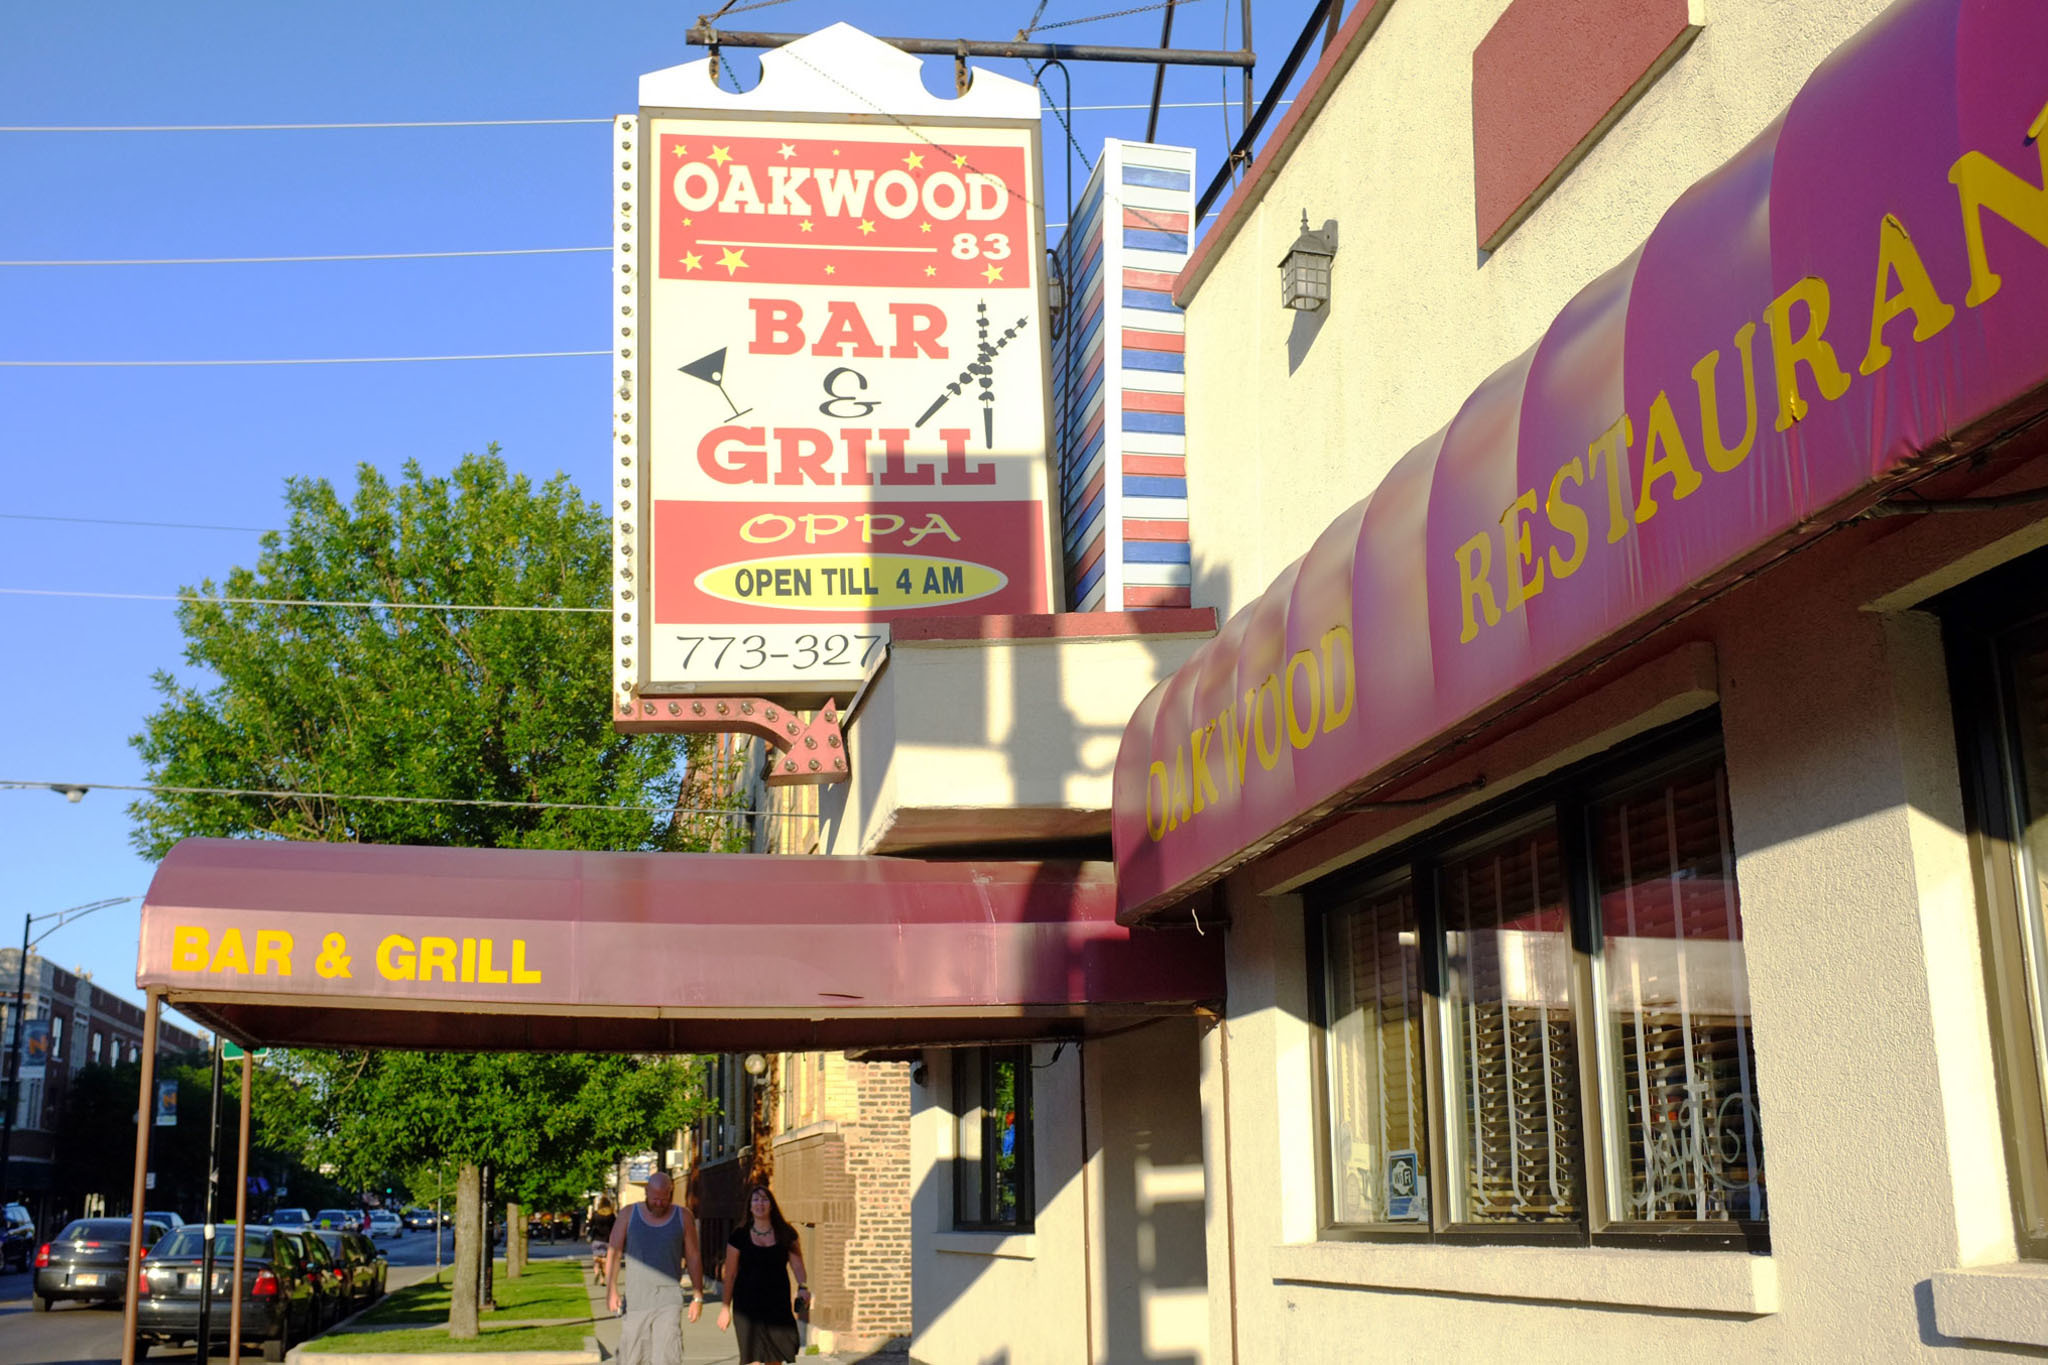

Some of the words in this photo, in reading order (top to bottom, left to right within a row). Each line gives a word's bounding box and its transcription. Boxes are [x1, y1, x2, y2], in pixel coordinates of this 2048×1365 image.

[673, 162, 1009, 221] OAKWOOD
[951, 232, 1012, 260] 83
[748, 298, 949, 359] BAR
[819, 367, 882, 418] &
[697, 425, 996, 486] GRILL
[739, 513, 961, 547] OPPA
[734, 568, 812, 597] OPEN
[821, 567, 879, 596] TILL
[895, 567, 912, 595] 4
[922, 566, 964, 595] AM
[1146, 625, 1356, 842] OAKWOOD
[171, 926, 294, 976] BAR
[315, 932, 353, 979] &
[376, 934, 542, 984] GRILL
